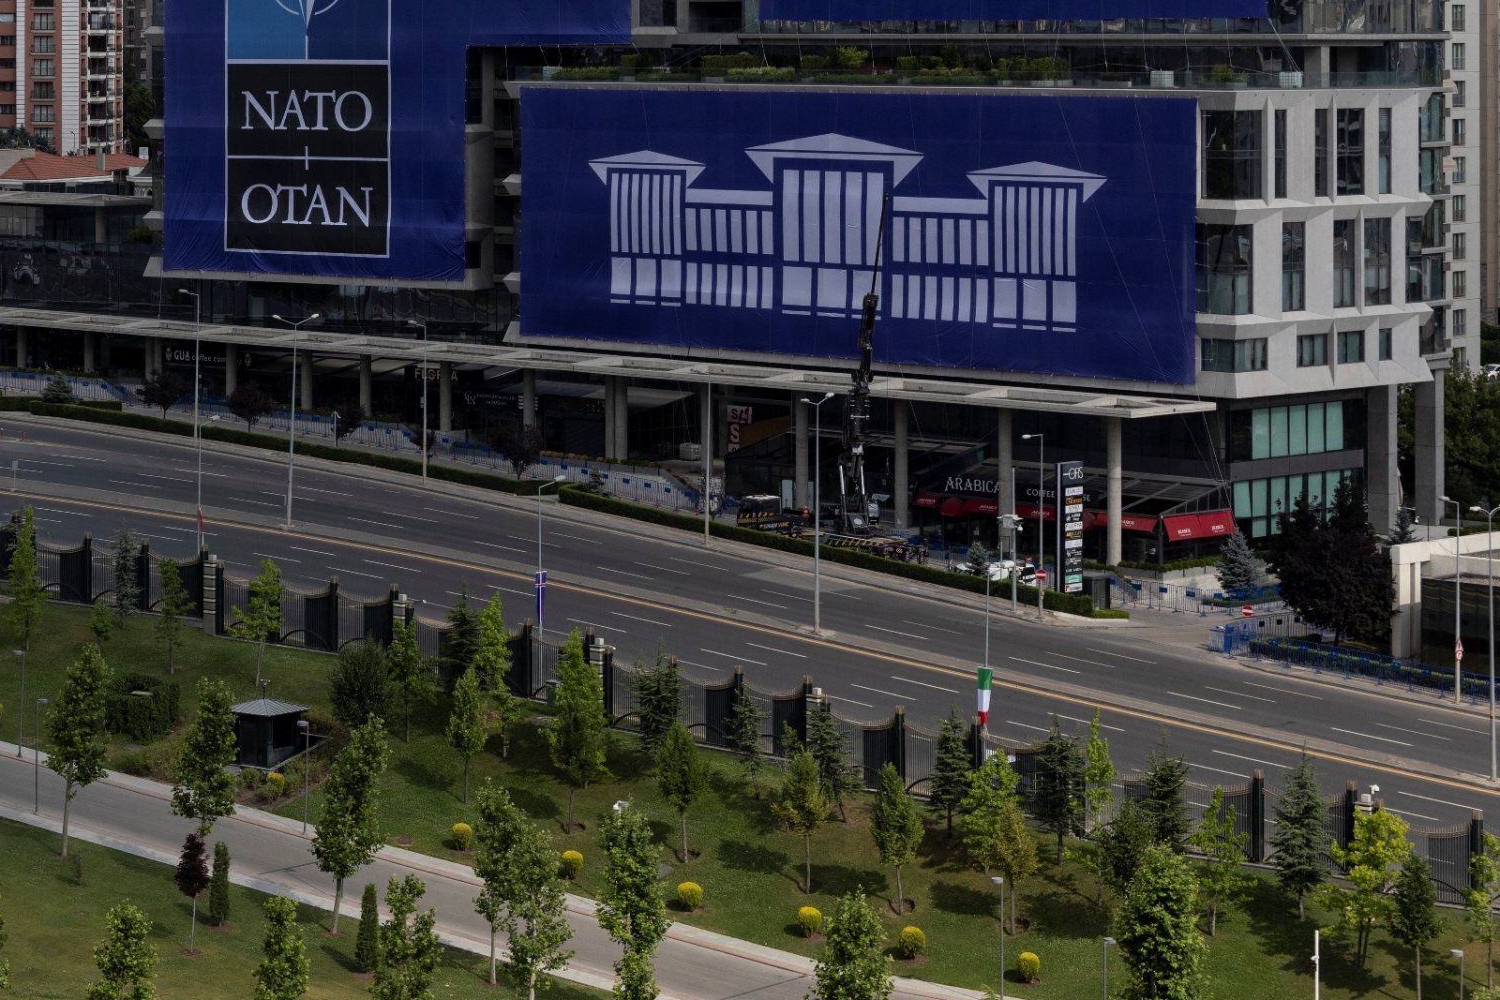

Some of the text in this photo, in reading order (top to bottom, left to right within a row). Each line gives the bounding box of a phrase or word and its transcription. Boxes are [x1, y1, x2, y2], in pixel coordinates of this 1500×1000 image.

[241, 89, 373, 132] NATO
[241, 183, 374, 228] OTAN
[174, 350, 190, 361] GUA
[944, 476, 1000, 495] ARABICA
[1026, 488, 1056, 499] COFFEE
